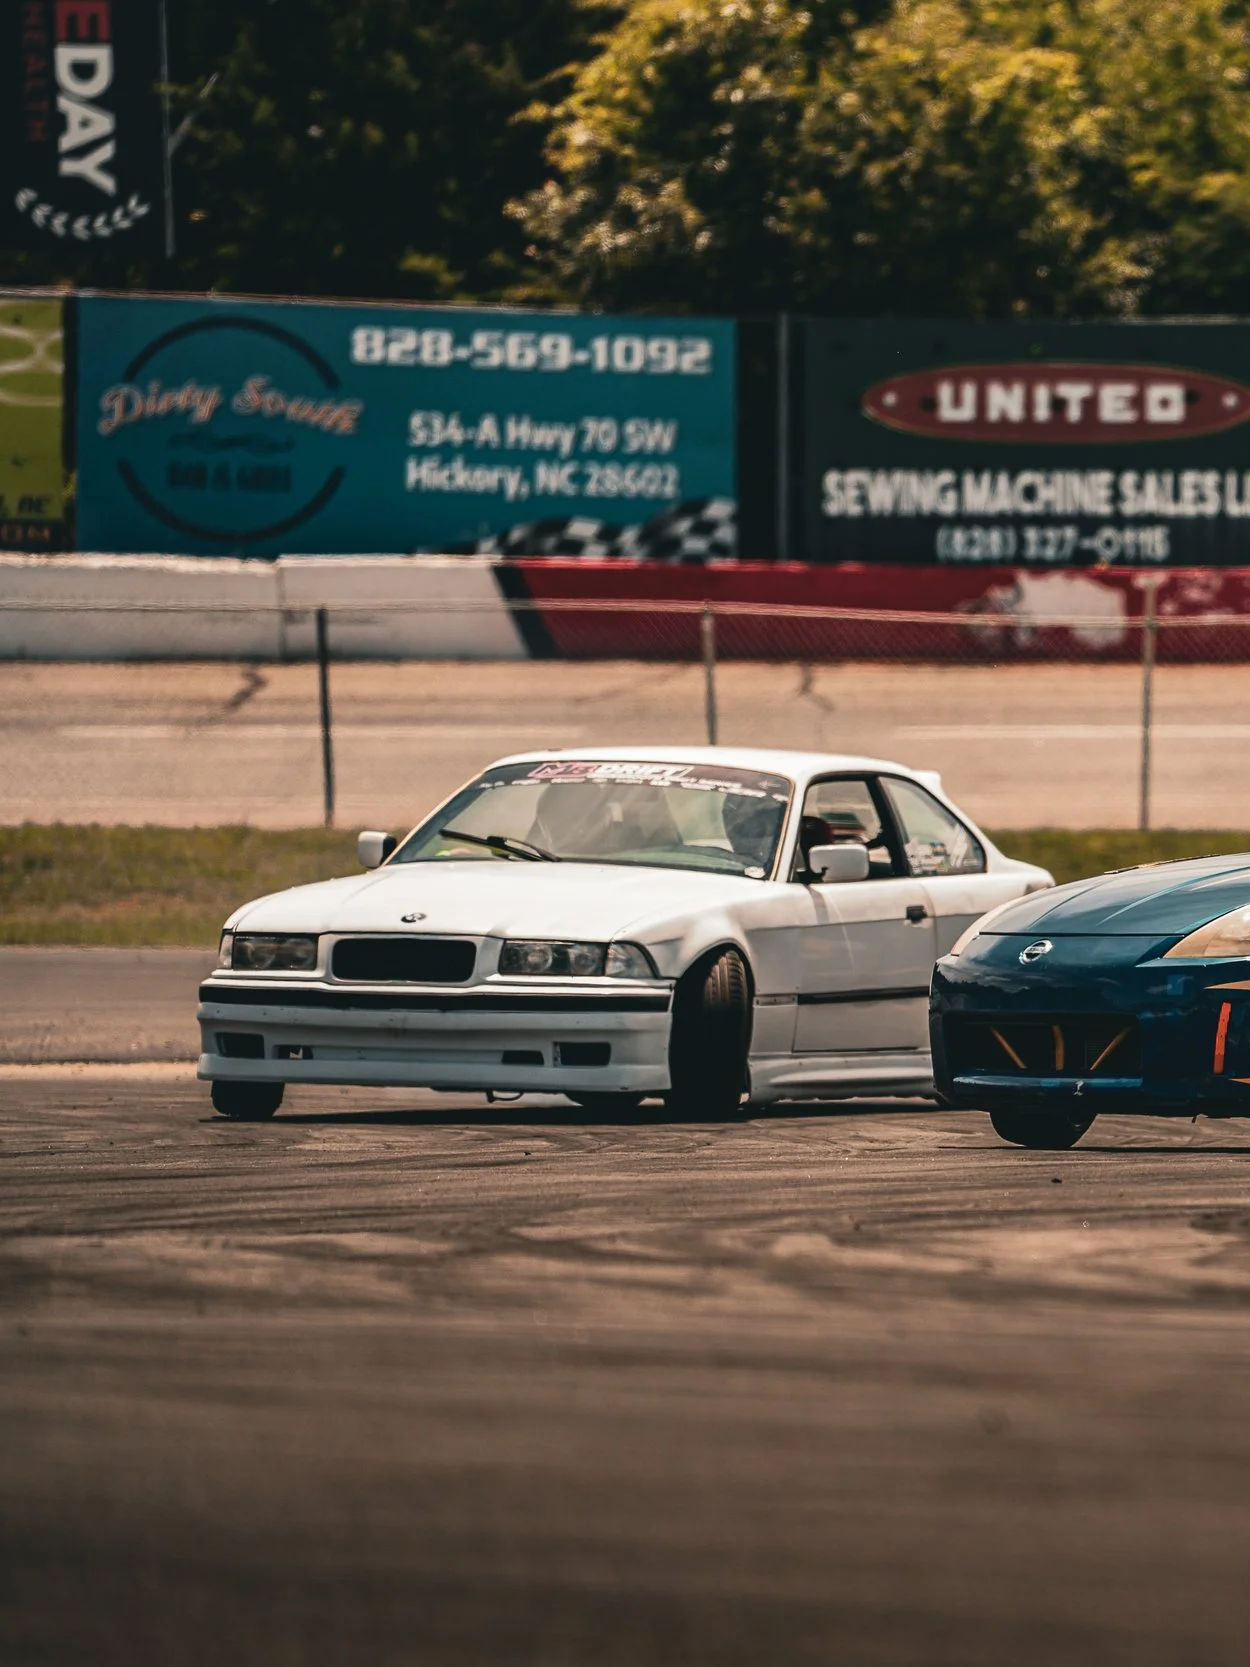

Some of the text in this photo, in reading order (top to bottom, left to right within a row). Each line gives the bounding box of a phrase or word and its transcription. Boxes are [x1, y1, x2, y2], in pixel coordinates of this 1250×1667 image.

[351, 325, 713, 375] 828-569-1092
[97, 377, 222, 436] Dirty
[936, 380, 1187, 423] UNITED
[409, 410, 678, 457] 534-A Hwy 70 SW
[405, 454, 681, 501] Hickory, NC 28602
[822, 468, 959, 518] SEWING
[961, 468, 1115, 518] MACHINE
[1118, 468, 1222, 518] SALES
